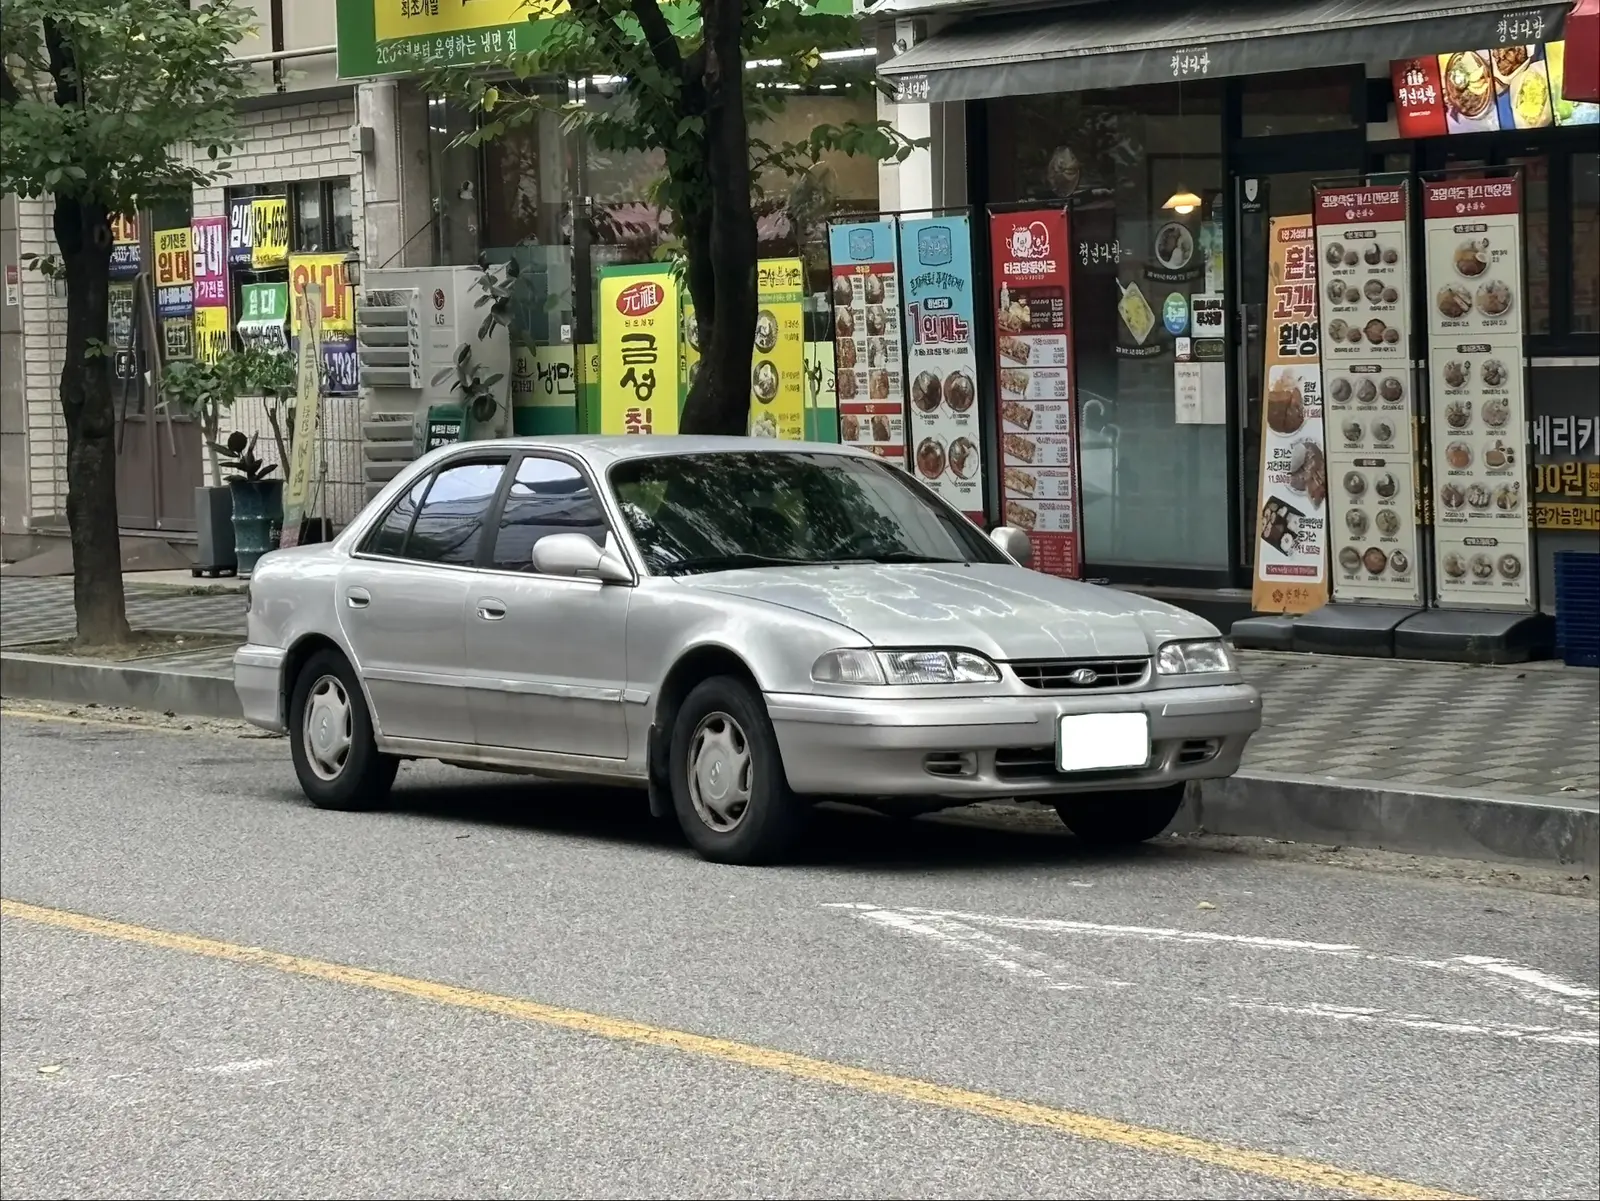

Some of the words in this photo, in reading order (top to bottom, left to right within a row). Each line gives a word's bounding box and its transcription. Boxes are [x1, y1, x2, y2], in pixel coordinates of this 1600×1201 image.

[1496, 15, 1545, 42] 청년다방
[435, 35, 476, 59] 운영하는
[481, 29, 502, 53] 냉면
[507, 28, 517, 50] 집
[1170, 51, 1211, 77] 청년다방
[1398, 84, 1436, 107] 청년다방
[160, 232, 187, 251] 상가전문
[192, 225, 223, 277] 임대
[1079, 239, 1122, 266] 청년다방
[158, 250, 190, 283] 임대
[622, 283, 659, 315] 元祖
[435, 313, 445, 325] LG
[1278, 321, 1318, 357] 환영
[620, 332, 658, 402] 금성
